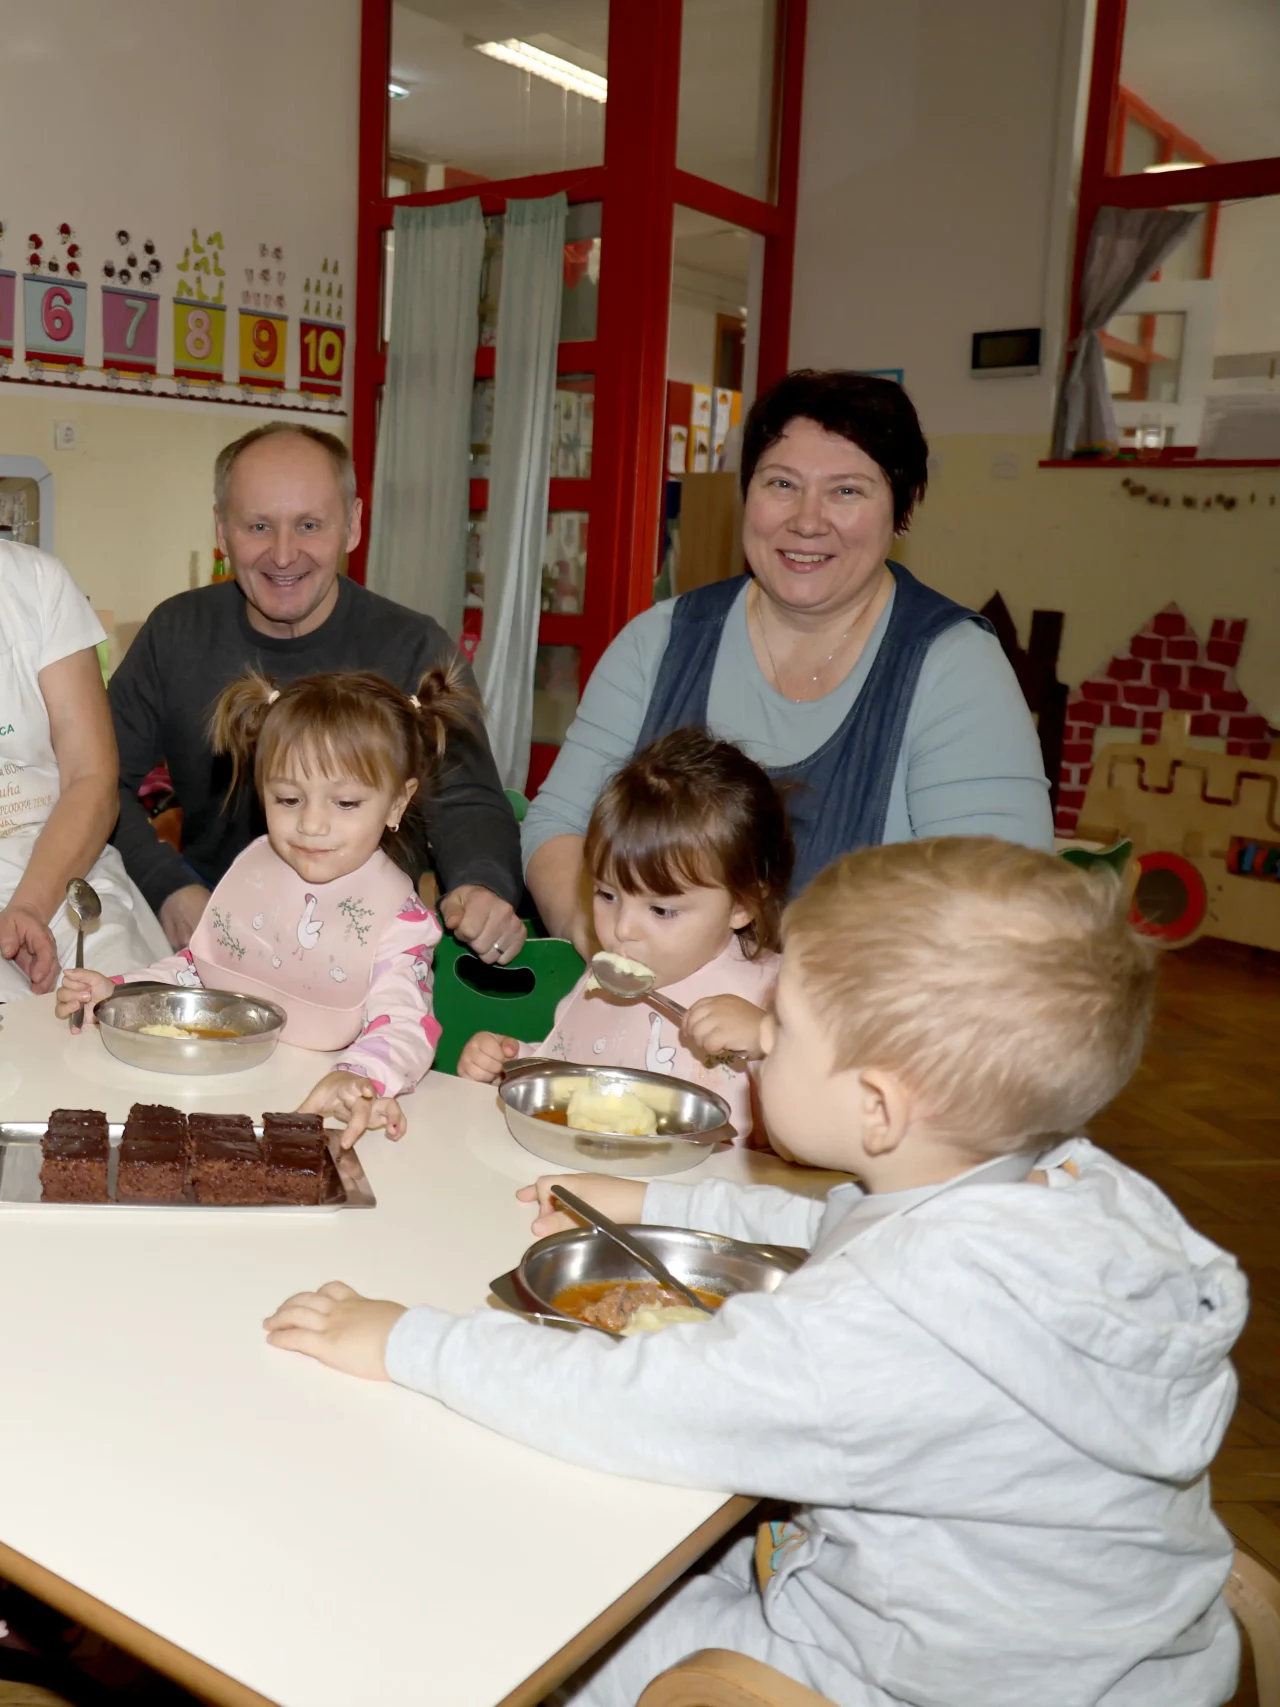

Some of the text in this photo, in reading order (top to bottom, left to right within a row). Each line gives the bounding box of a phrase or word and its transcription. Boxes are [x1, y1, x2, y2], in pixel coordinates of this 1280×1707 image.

[41, 287, 74, 342] 6
[125, 298, 149, 350] 7
[185, 309, 212, 359] 8
[253, 319, 278, 368] 9
[303, 328, 342, 376] 10
